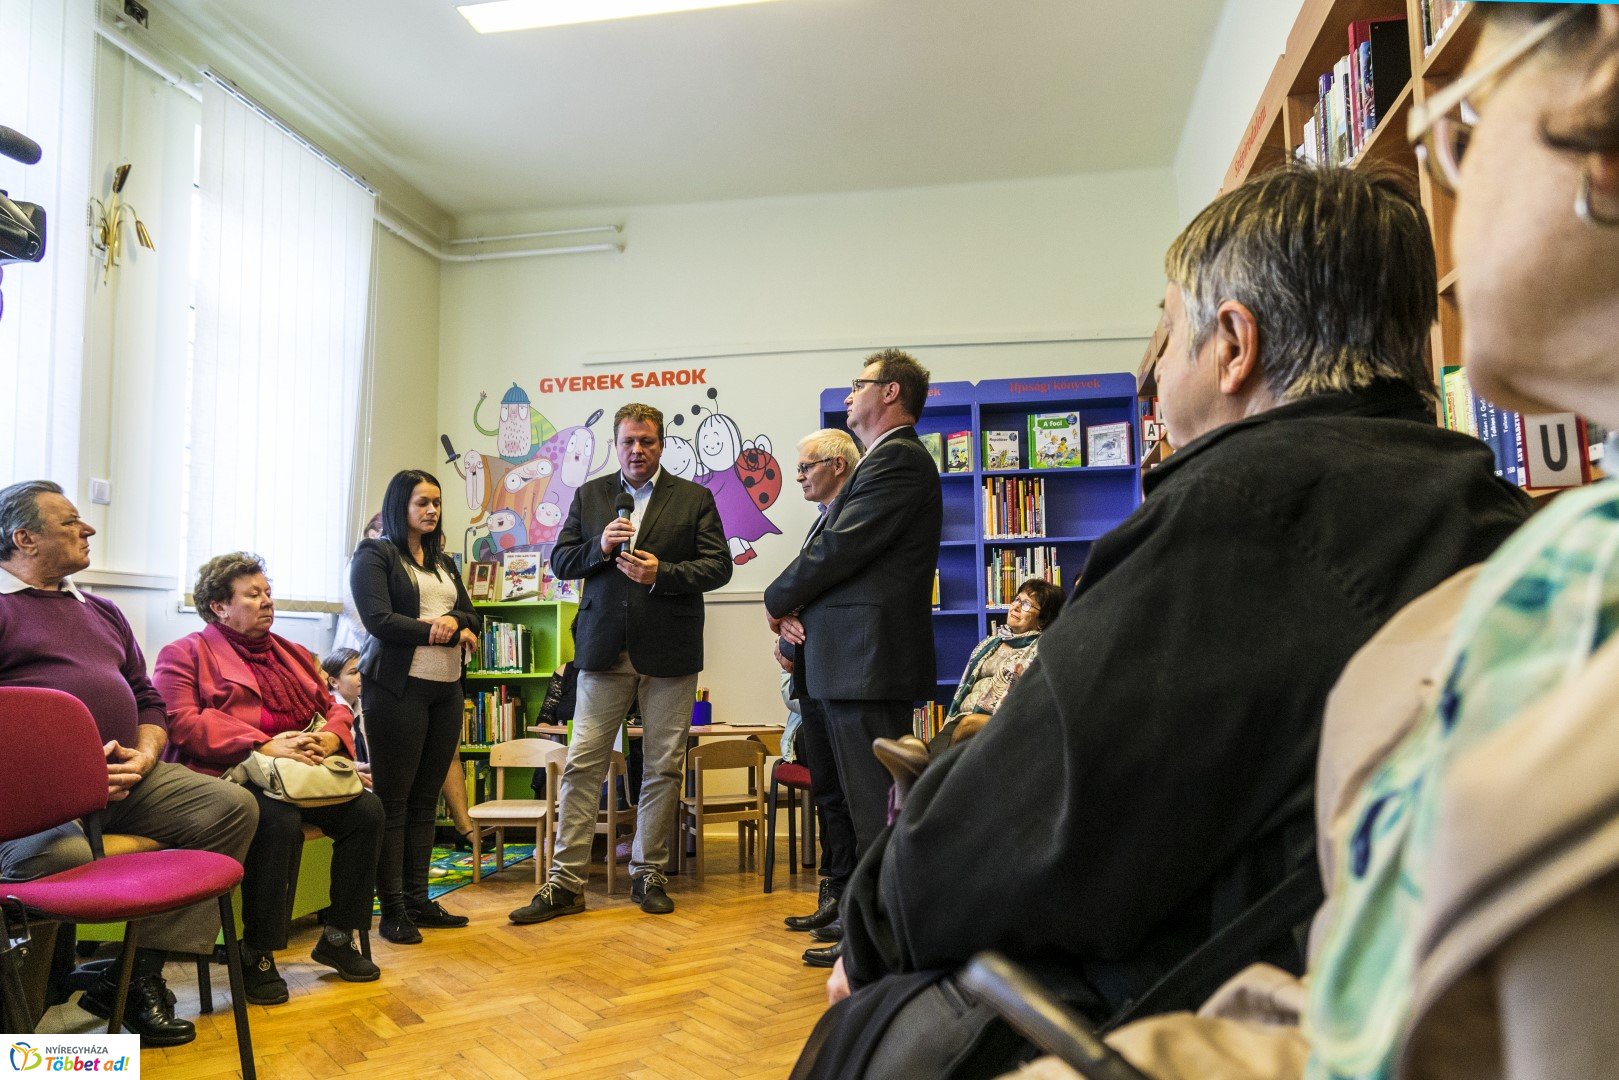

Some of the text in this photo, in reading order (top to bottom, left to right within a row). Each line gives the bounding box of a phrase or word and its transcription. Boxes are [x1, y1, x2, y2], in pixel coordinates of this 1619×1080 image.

[539, 368, 707, 394] GYEREK SAROK
[1147, 424, 1156, 436] A
[1539, 423, 1568, 472] U
